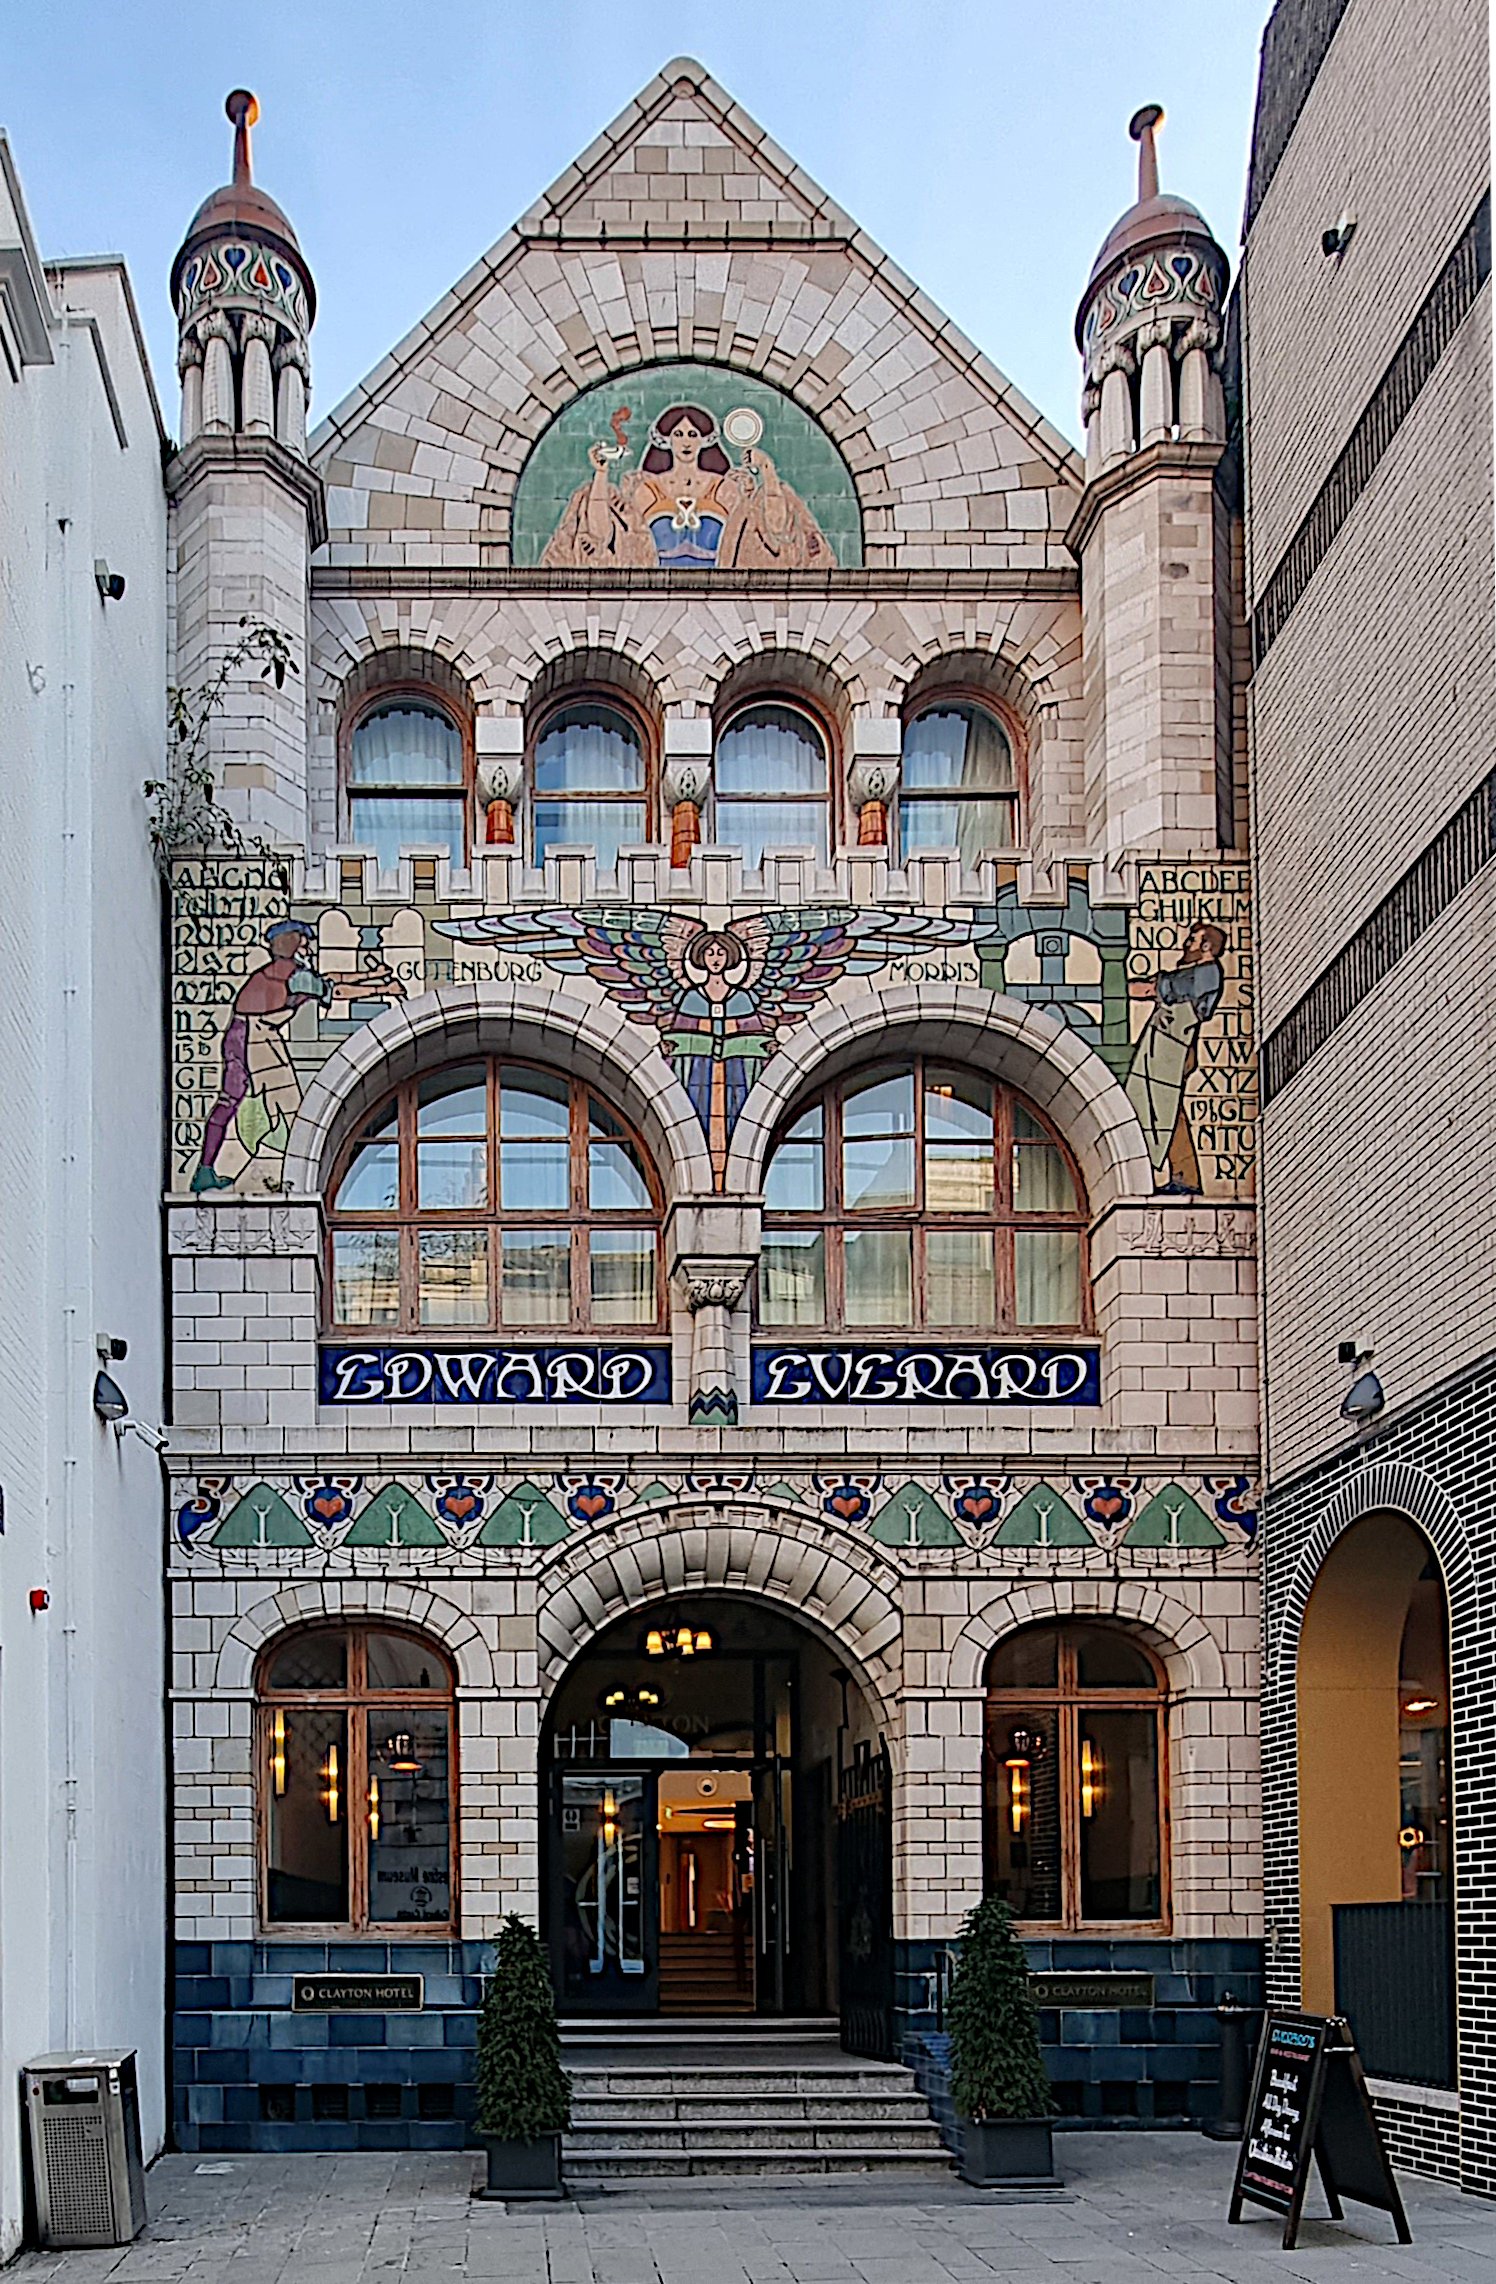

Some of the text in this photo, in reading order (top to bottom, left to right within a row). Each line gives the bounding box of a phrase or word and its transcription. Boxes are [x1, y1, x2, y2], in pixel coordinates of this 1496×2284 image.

[889, 962, 979, 982] MORRIS
[333, 1352, 653, 1399] EDWARD
[763, 1353, 1088, 1399] EVERARD
[318, 1987, 414, 1999] CLAYTON HOTEL
[1052, 1986, 1106, 1997] CLAYTON
